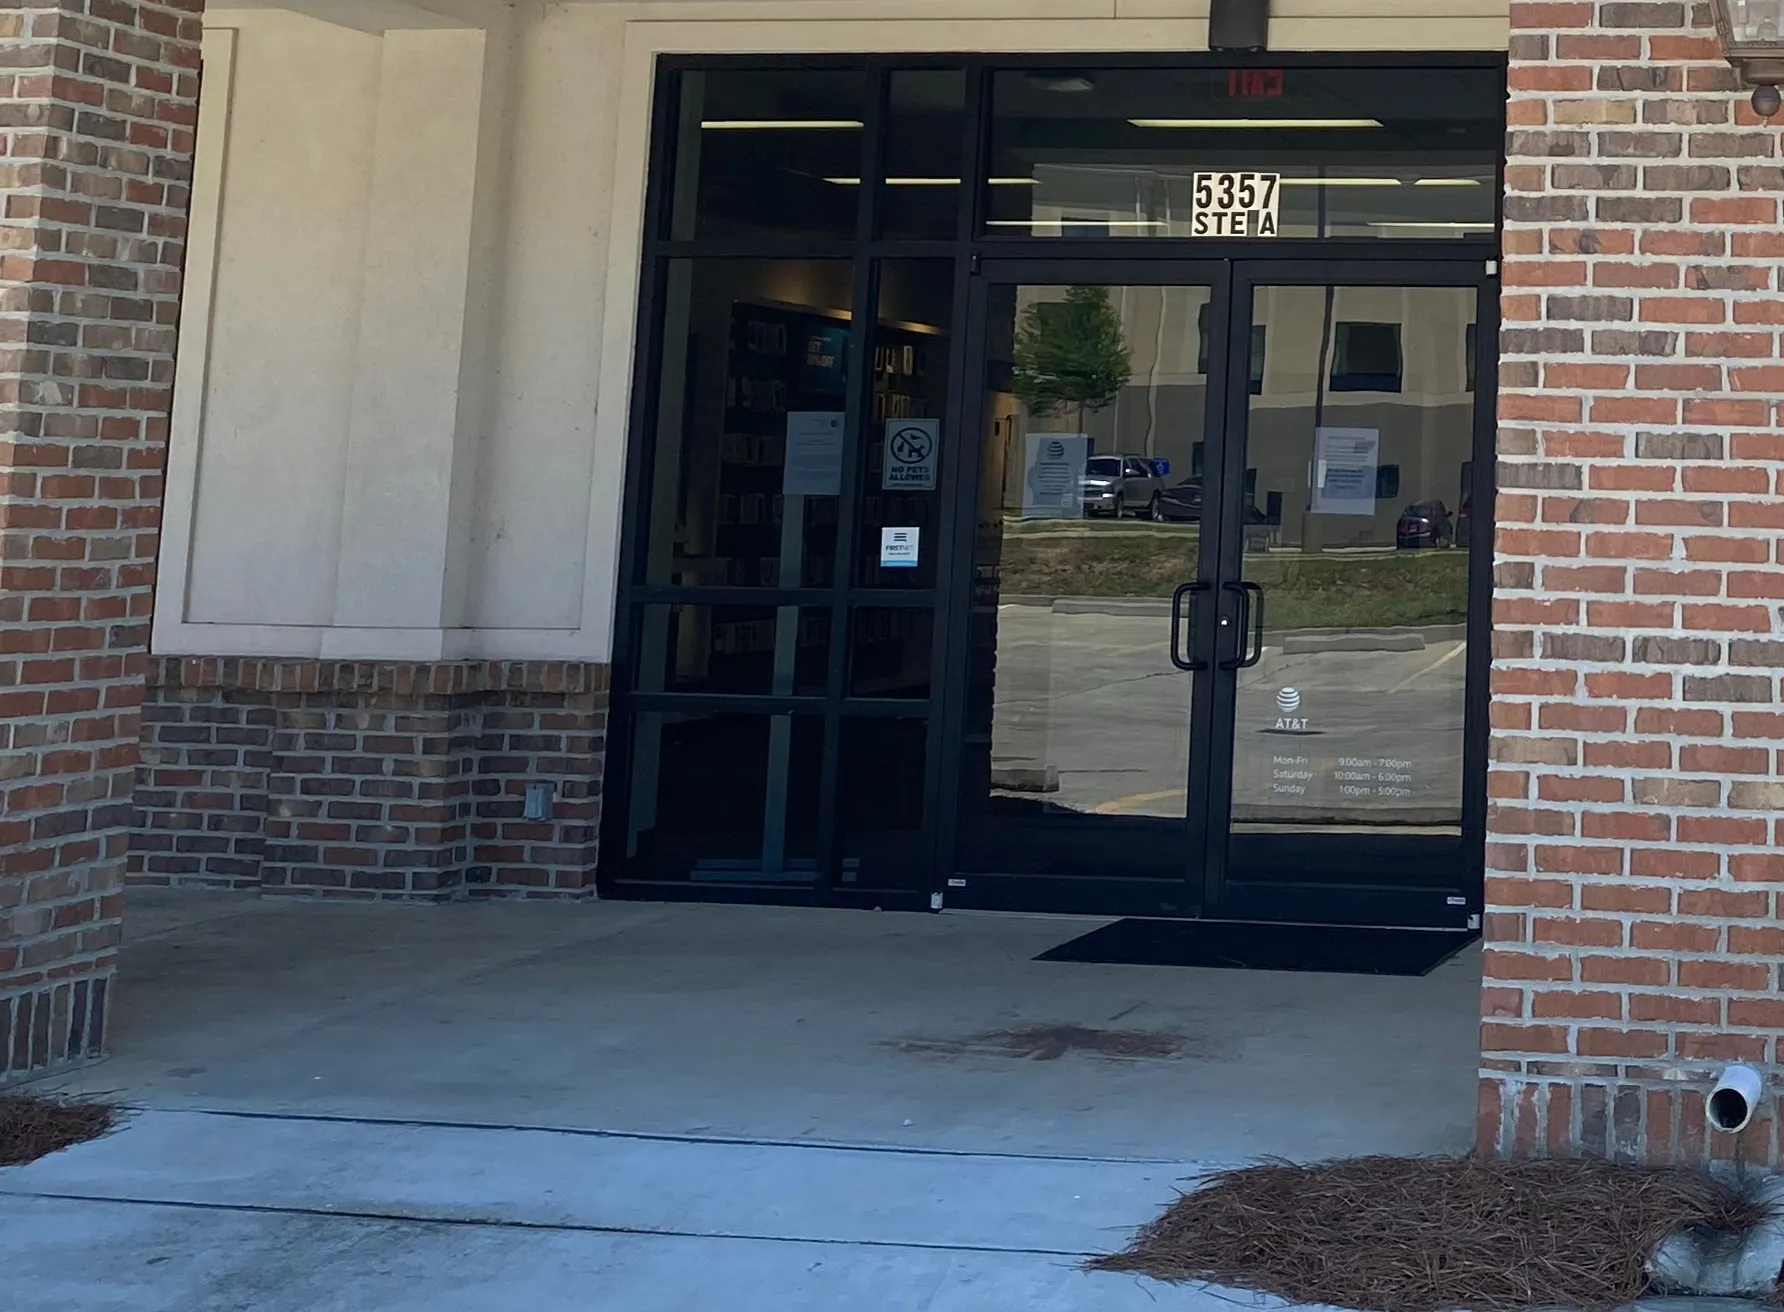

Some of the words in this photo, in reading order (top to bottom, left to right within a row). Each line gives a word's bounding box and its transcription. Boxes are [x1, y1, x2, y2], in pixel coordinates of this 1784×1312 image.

[1195, 174, 1278, 210] 5357
[1194, 211, 1246, 235] STE
[1259, 211, 1276, 235] A
[889, 473, 931, 481] ALLOWED
[906, 466, 930, 474] PETS
[1275, 718, 1309, 730] AT&T
[1273, 755, 1309, 765] Mon-Fri
[1379, 758, 1412, 770] 7:00pm
[1272, 769, 1313, 782] Saturday
[1334, 771, 1371, 781] 10:00am
[1378, 772, 1412, 784] 6:00pm
[1272, 783, 1306, 796] Sunday
